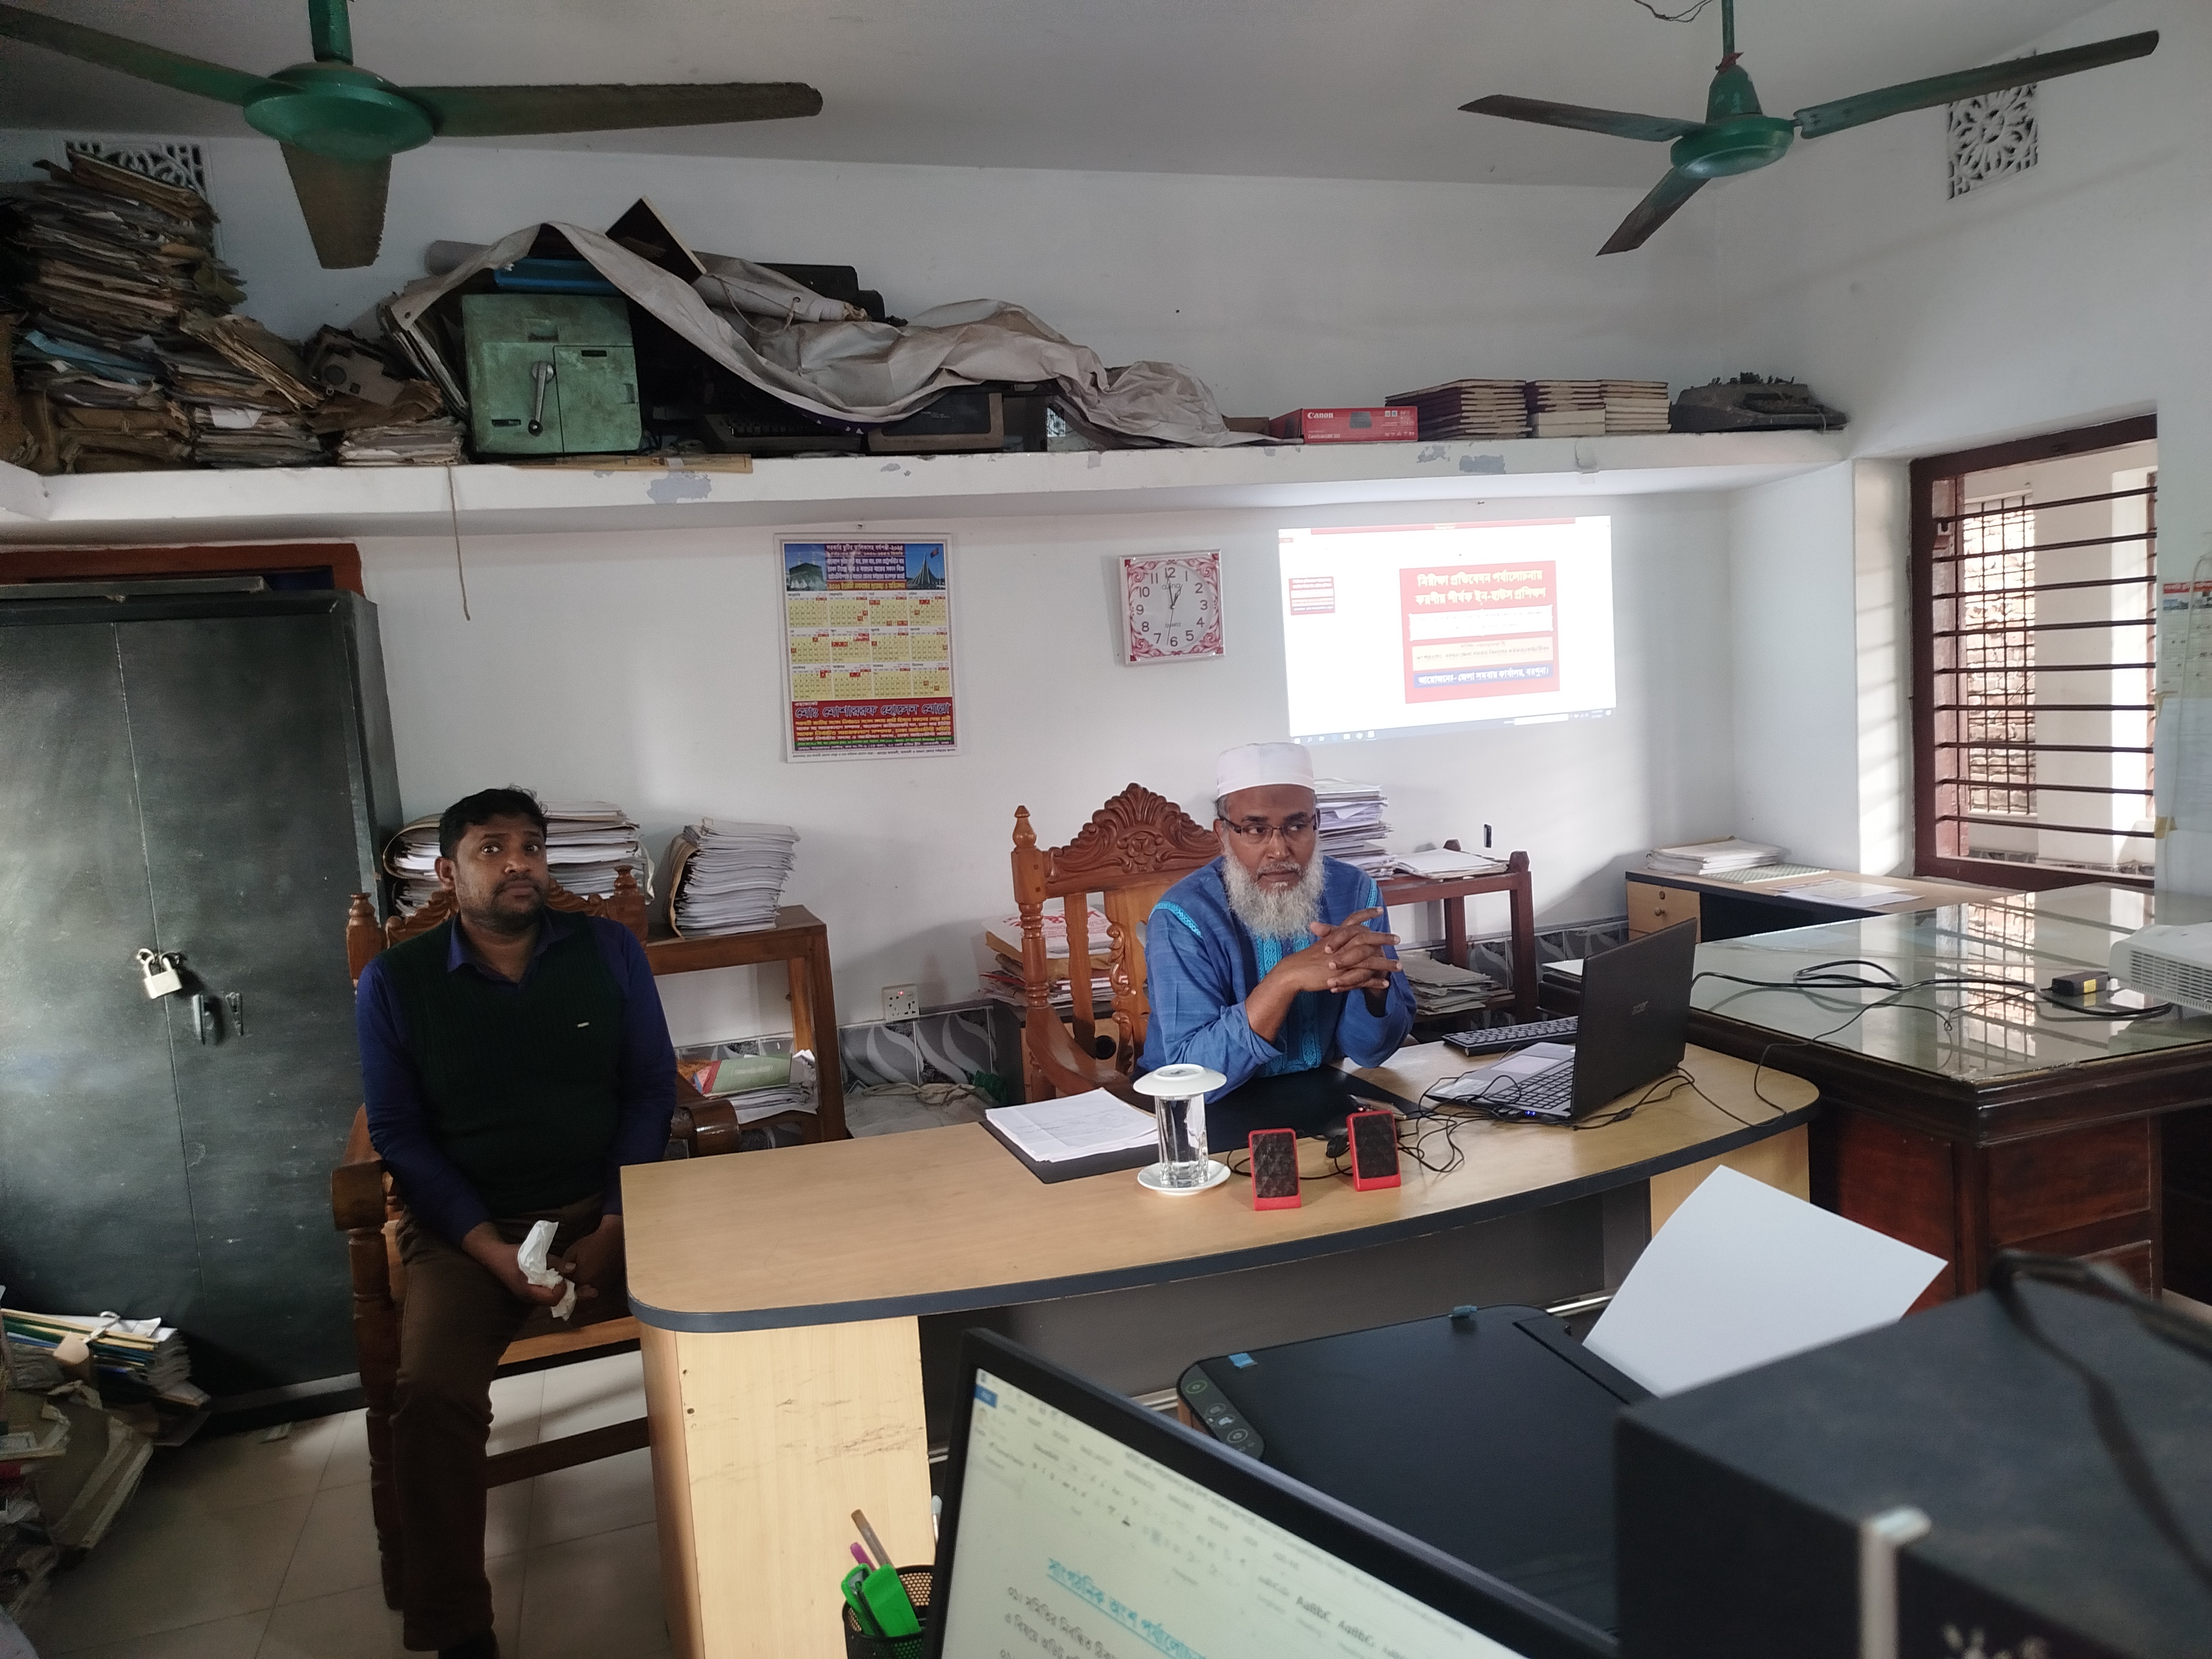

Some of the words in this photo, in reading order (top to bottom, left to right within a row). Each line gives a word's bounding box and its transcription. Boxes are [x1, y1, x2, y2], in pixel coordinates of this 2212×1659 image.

[1151, 572, 1158, 584] 11
[1165, 567, 1176, 578] 12
[1185, 570, 1188, 582] 1
[1417, 573, 1449, 587] নিরীক্ষা
[1450, 571, 1491, 586] প্রতিবেদন
[1492, 569, 1543, 583] পর্যালোচনায়
[1140, 586, 1150, 598] 10
[1194, 582, 1203, 593] 2
[1415, 591, 1446, 606] করণীয়
[1447, 589, 1473, 603] শীর্ষক
[1474, 587, 1513, 602] ইন-হাউস
[1514, 586, 1546, 601] প্রশিক্ষণ
[1136, 604, 1144, 615] 9
[1199, 599, 1208, 610] 3
[1141, 621, 1150, 632] 8
[1196, 617, 1205, 628] 4
[1154, 633, 1161, 644] 7
[1186, 630, 1194, 641] 5
[1170, 636, 1178, 647] 6
[1458, 672, 1475, 682] জেলা
[1475, 670, 1498, 680] সমবায়
[795, 707, 818, 718] মোঃ
[822, 705, 878, 718] মোশাররফ
[880, 703, 919, 717] হোসেন
[921, 702, 951, 714] মোল্লা
